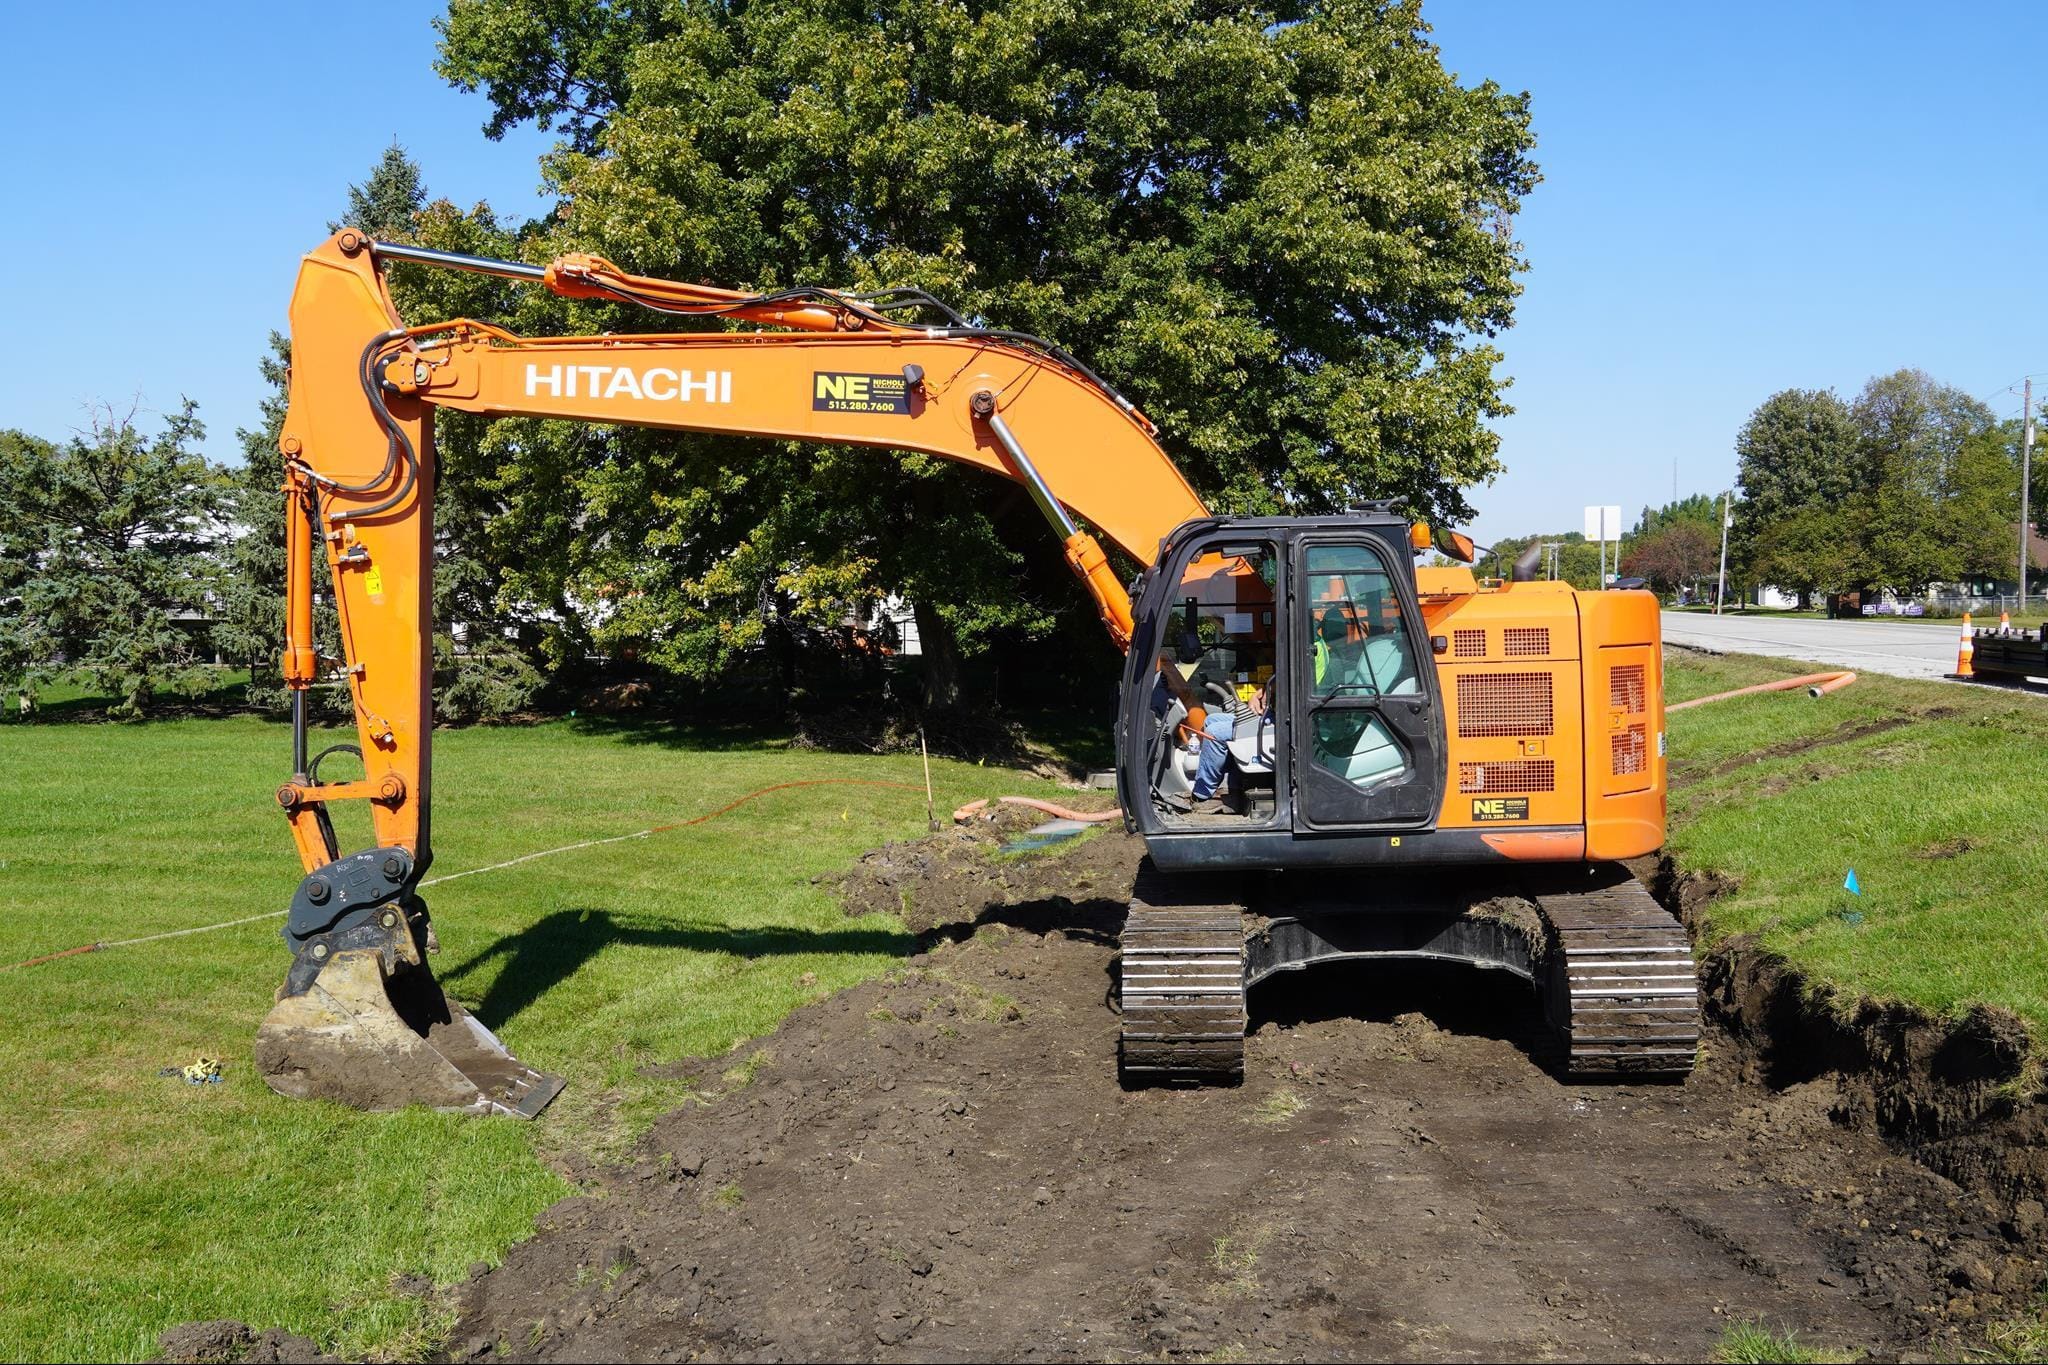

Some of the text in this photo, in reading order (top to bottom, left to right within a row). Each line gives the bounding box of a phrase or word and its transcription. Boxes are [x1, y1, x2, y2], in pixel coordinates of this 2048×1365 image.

[525, 364, 732, 403] HITACHI
[816, 375, 870, 400] NE
[828, 401, 895, 411] 515.280.7600
[1474, 800, 1505, 814] NE
